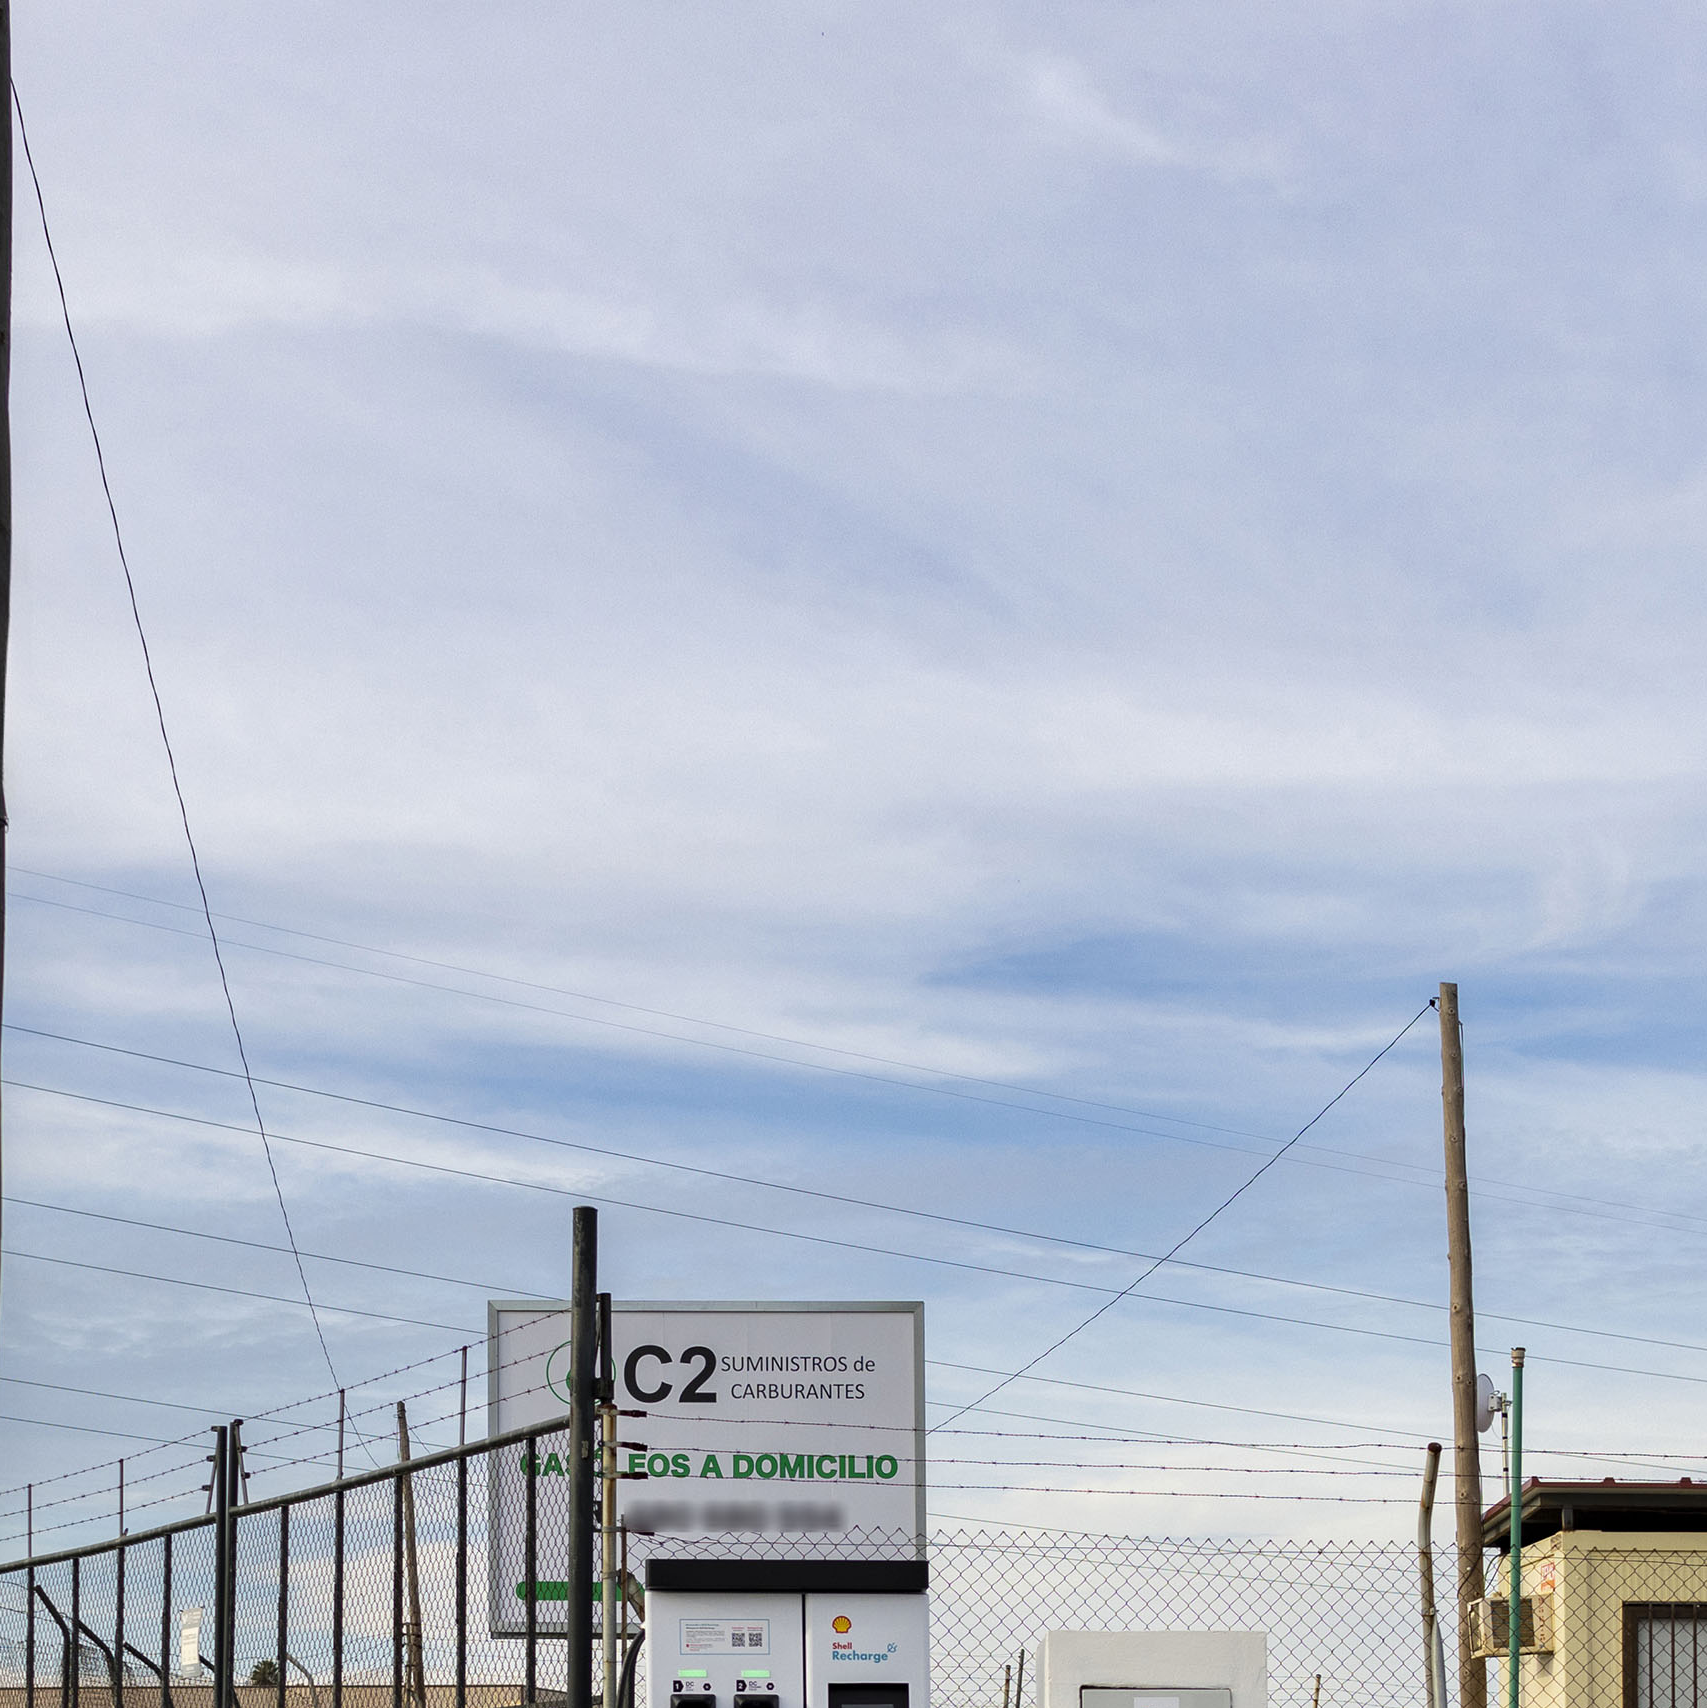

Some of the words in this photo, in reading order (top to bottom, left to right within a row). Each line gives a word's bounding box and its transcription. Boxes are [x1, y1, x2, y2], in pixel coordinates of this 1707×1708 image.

[721, 1356, 848, 1373] SUMINISTROS
[853, 1356, 876, 1373] de
[624, 1345, 717, 1403] C2
[731, 1383, 865, 1400] CARBURANTES
[699, 1454, 723, 1479] A
[733, 1453, 899, 1480] DOMICILIO
[832, 1642, 853, 1650] Shell
[832, 1650, 889, 1664] Recharge
